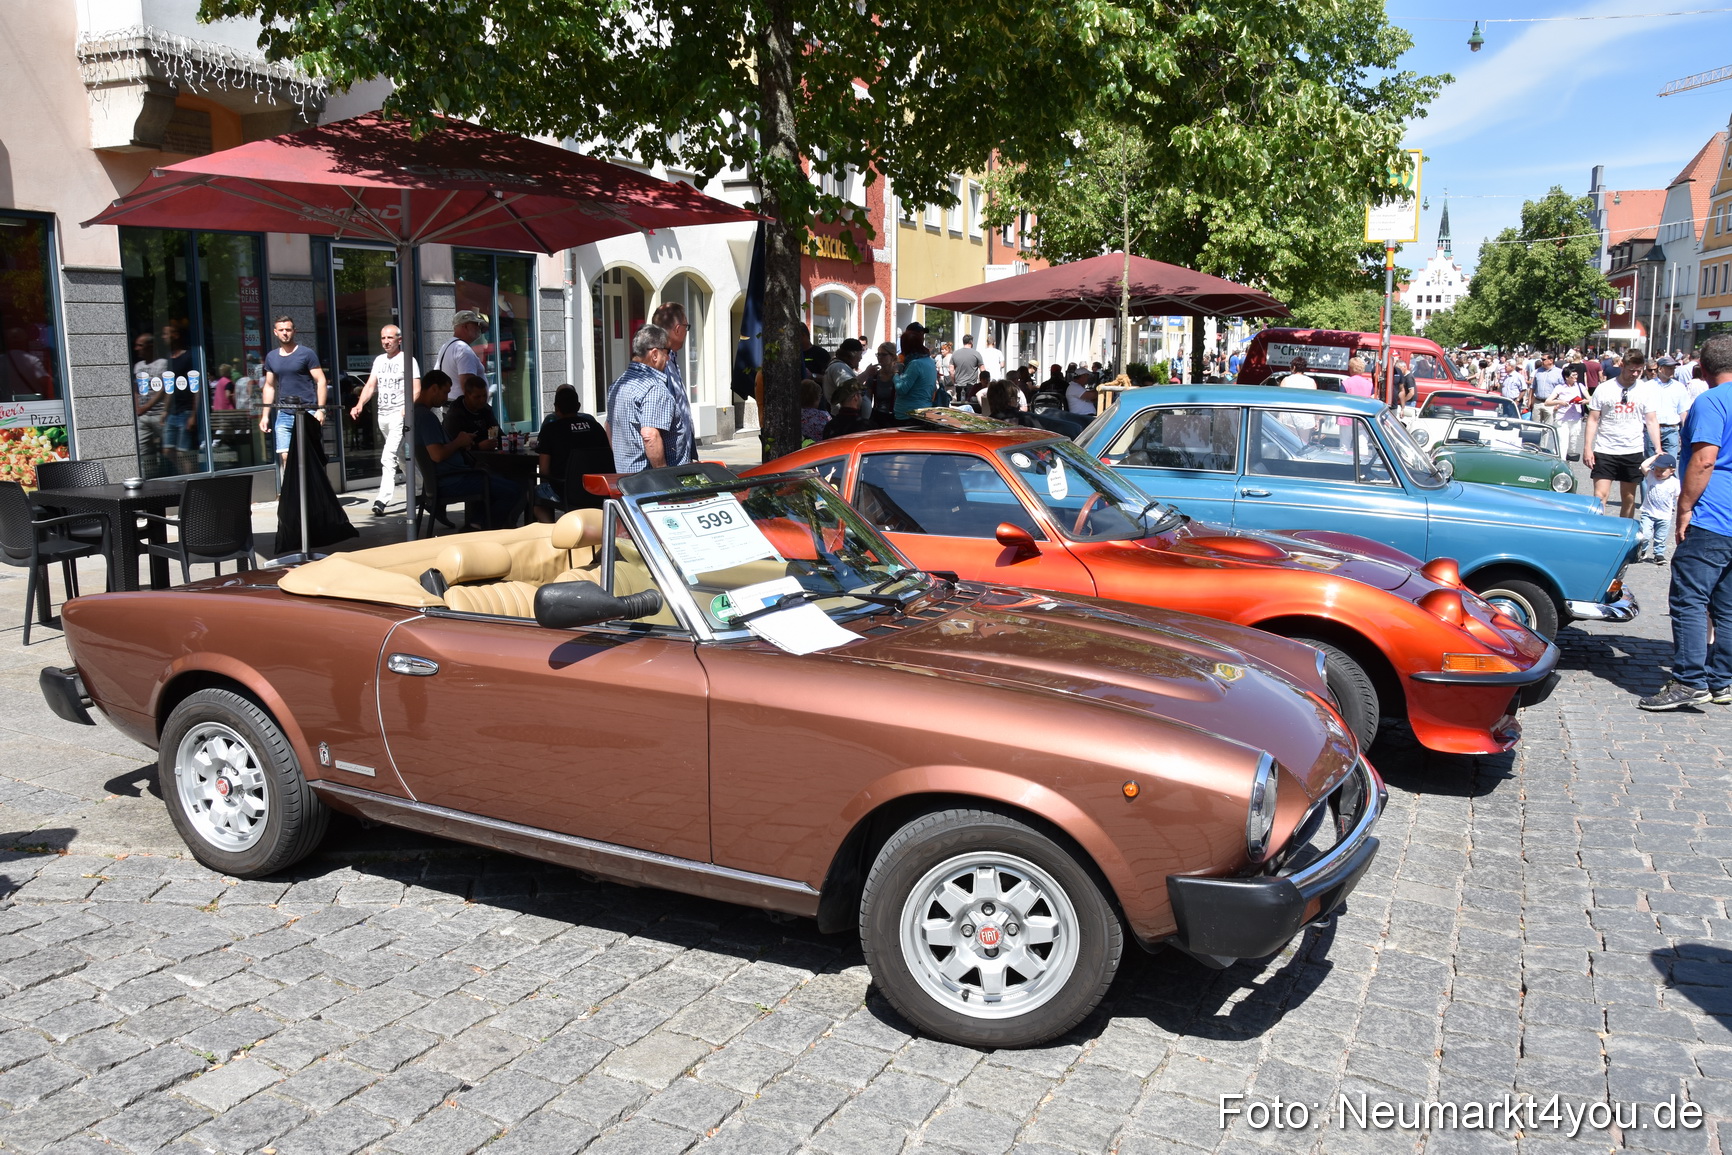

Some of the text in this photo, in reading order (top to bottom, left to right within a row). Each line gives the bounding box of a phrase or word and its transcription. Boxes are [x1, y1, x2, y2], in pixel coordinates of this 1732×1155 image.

[815, 234, 852, 261] BÄCKE
[241, 287, 259, 295] REISE
[378, 377, 400, 390] EACH
[1614, 401, 1635, 414] 58
[30, 414, 62, 426] Pizza
[696, 510, 733, 530] 599
[720, 596, 731, 608] 4
[981, 930, 998, 943] FIAT
